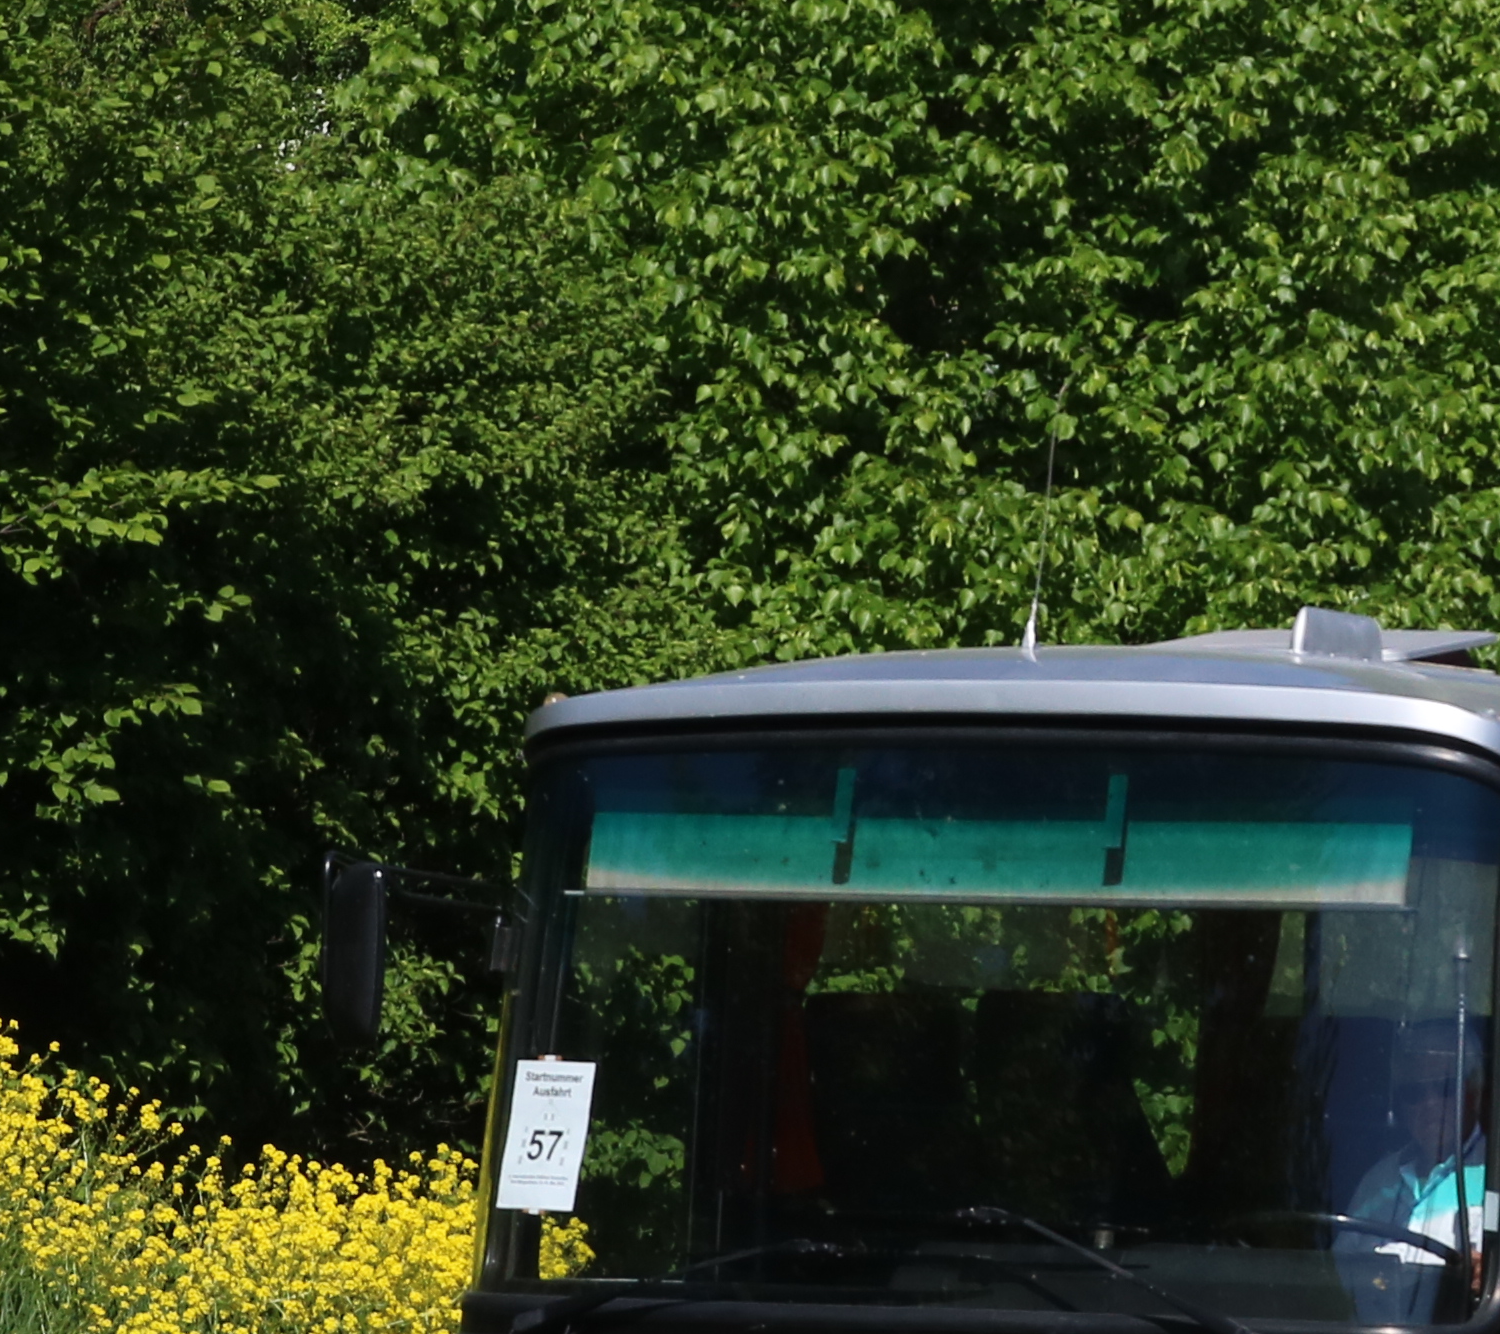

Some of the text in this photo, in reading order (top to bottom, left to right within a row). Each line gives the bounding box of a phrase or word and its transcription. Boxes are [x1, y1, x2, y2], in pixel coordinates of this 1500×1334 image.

[525, 1070, 583, 1083] Startnummer
[533, 1086, 572, 1098] Ausfahrt
[526, 1130, 564, 1161] 57
